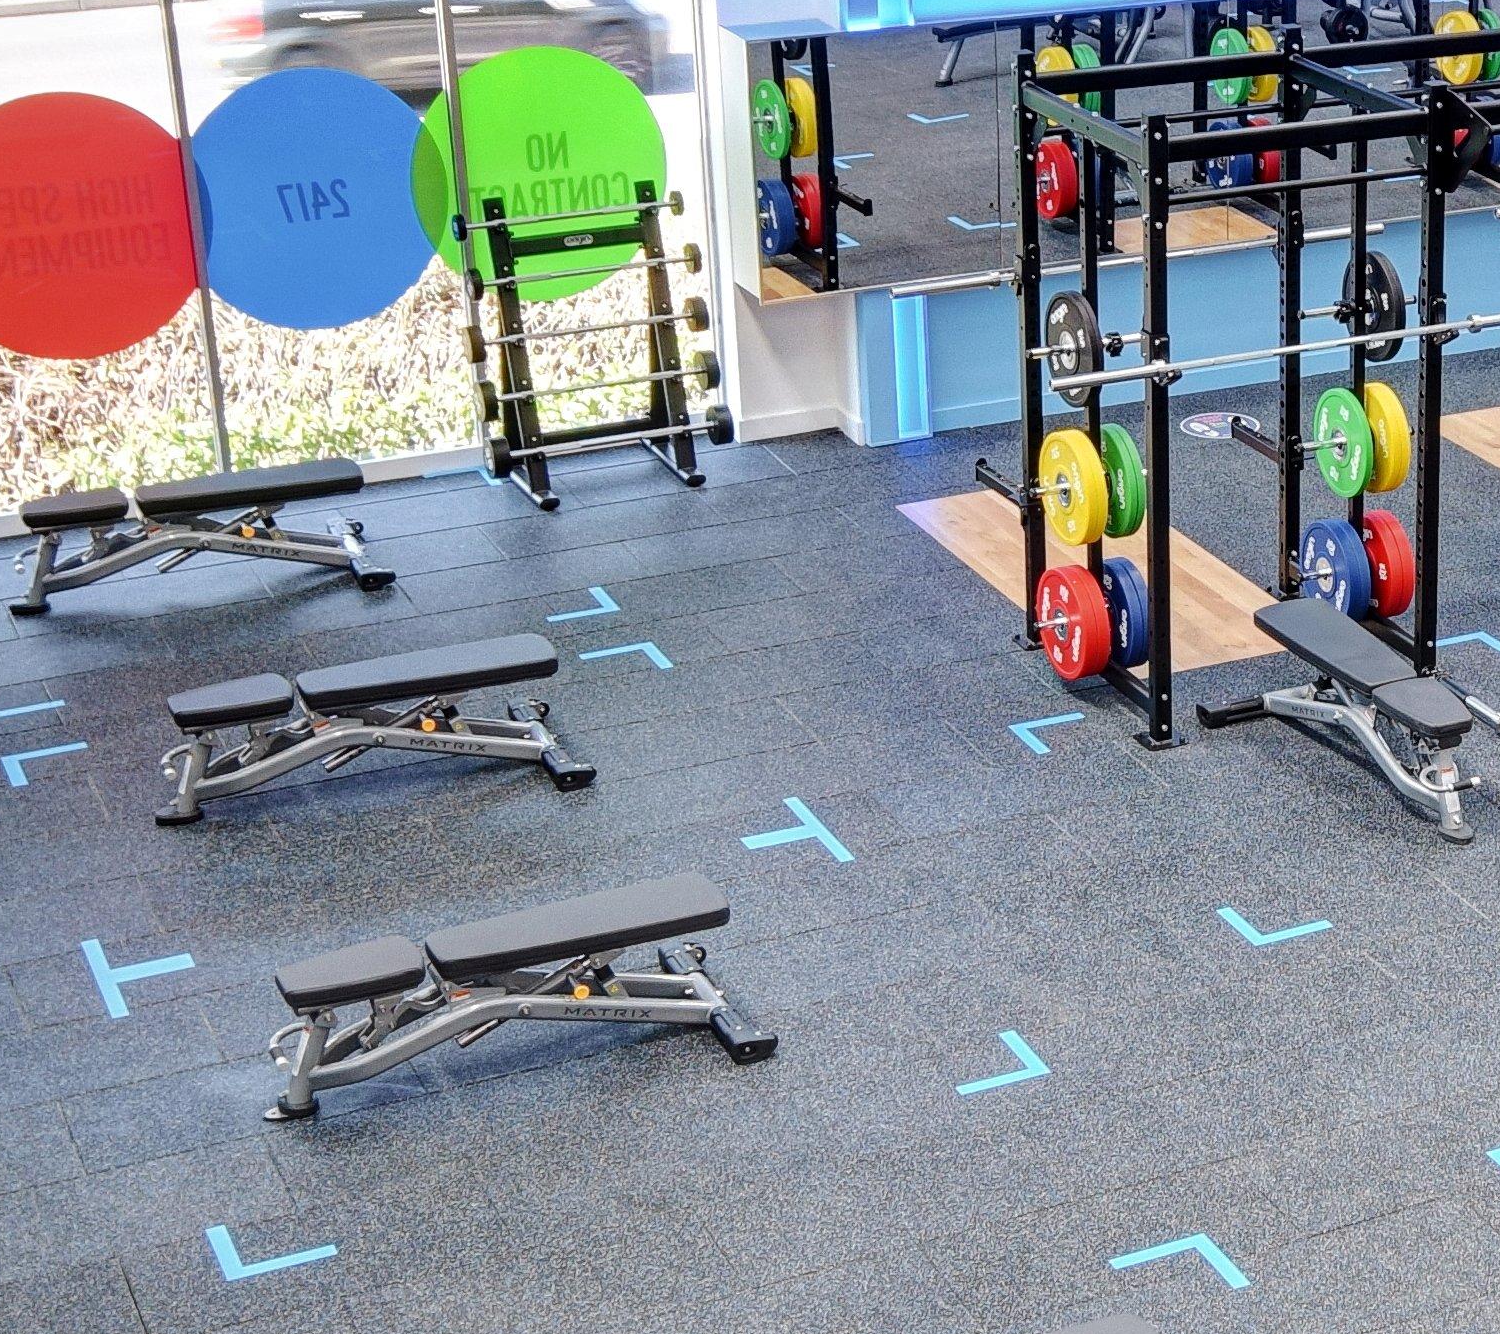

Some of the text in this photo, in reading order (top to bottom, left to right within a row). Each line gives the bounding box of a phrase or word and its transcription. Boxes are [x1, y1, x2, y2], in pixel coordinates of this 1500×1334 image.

[232, 541, 301, 558] MATRIX
[409, 738, 487, 752] MATRIX
[564, 1006, 652, 1019] MATRIX
